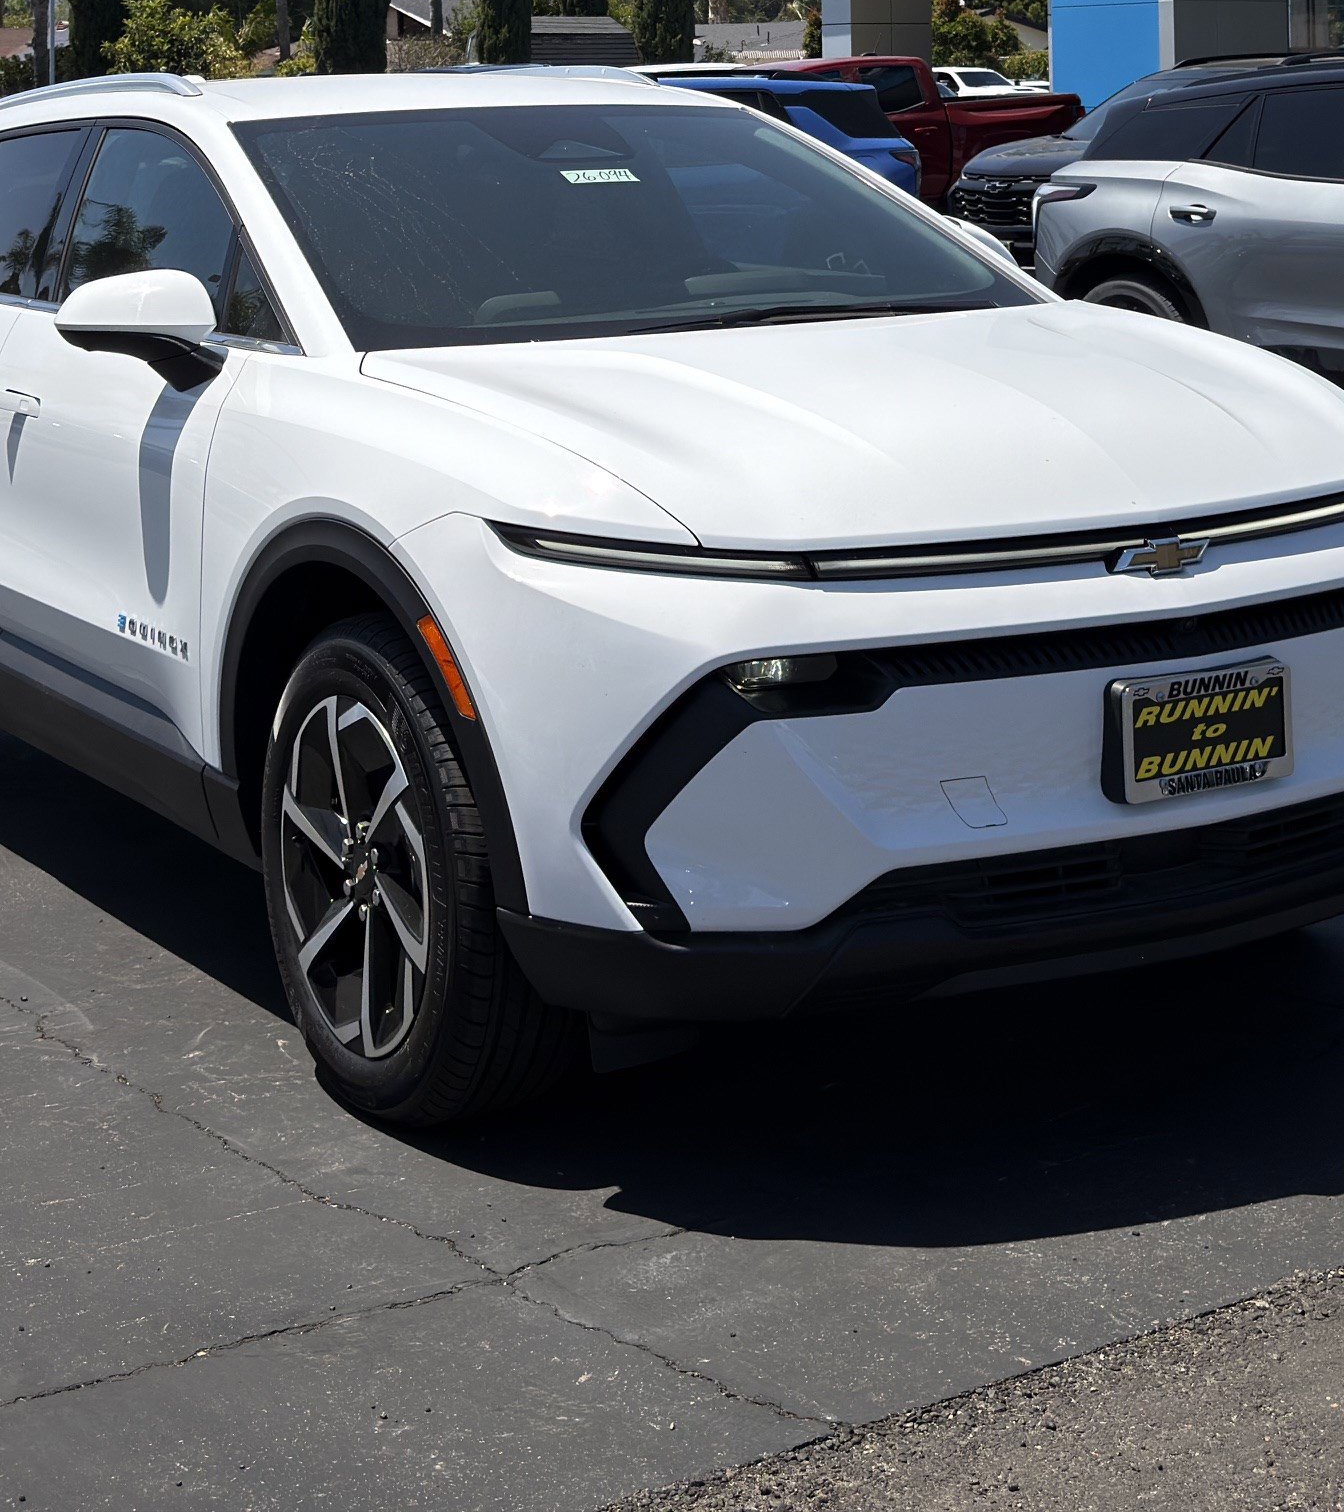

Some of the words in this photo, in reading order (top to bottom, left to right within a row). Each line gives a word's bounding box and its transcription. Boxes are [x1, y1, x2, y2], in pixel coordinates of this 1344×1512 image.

[1167, 671, 1249, 699] BUNNIN
[1134, 686, 1279, 728] RUNNIN'
[1191, 722, 1227, 741] to
[1135, 735, 1275, 780] BUNNIN
[1168, 770, 1212, 796] SANTA
